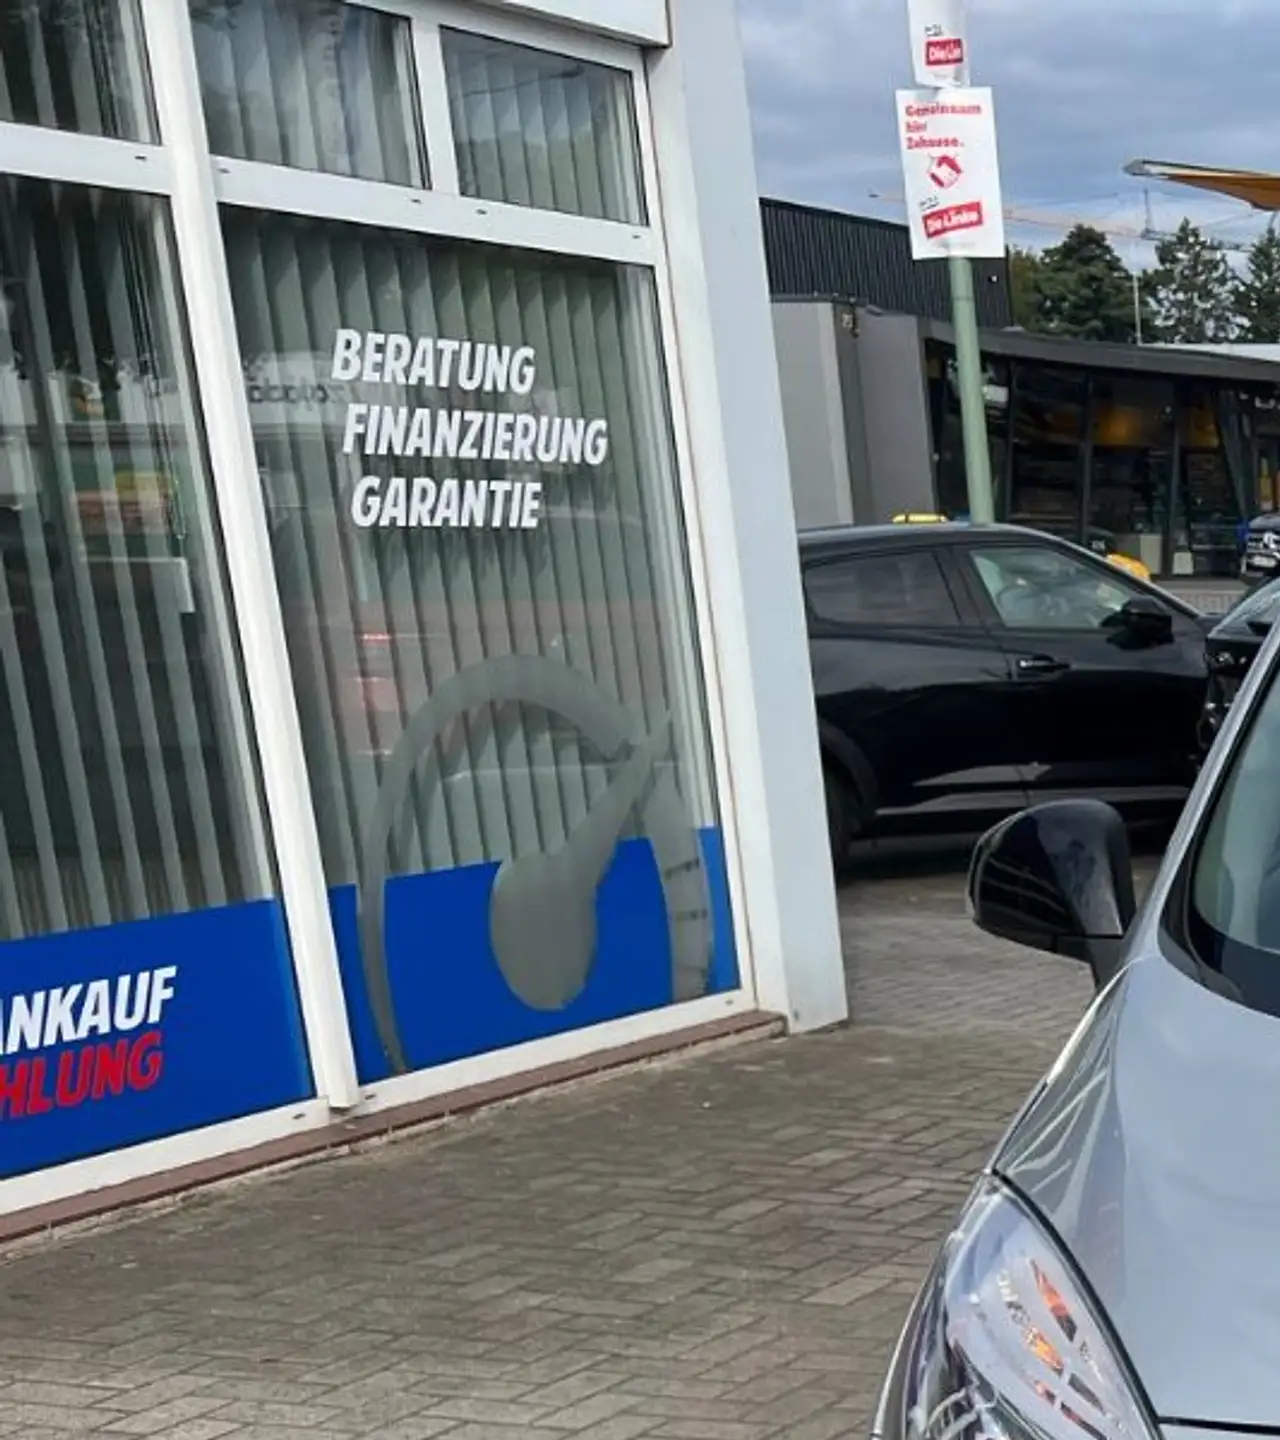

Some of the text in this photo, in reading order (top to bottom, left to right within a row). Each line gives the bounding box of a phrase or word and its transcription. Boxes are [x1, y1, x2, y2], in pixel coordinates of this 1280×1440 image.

[331, 328, 536, 395] BERATUNG
[343, 403, 609, 465] FINANZIERUNG
[351, 475, 543, 529] GARANTIE
[0, 965, 178, 1056] NKAUF
